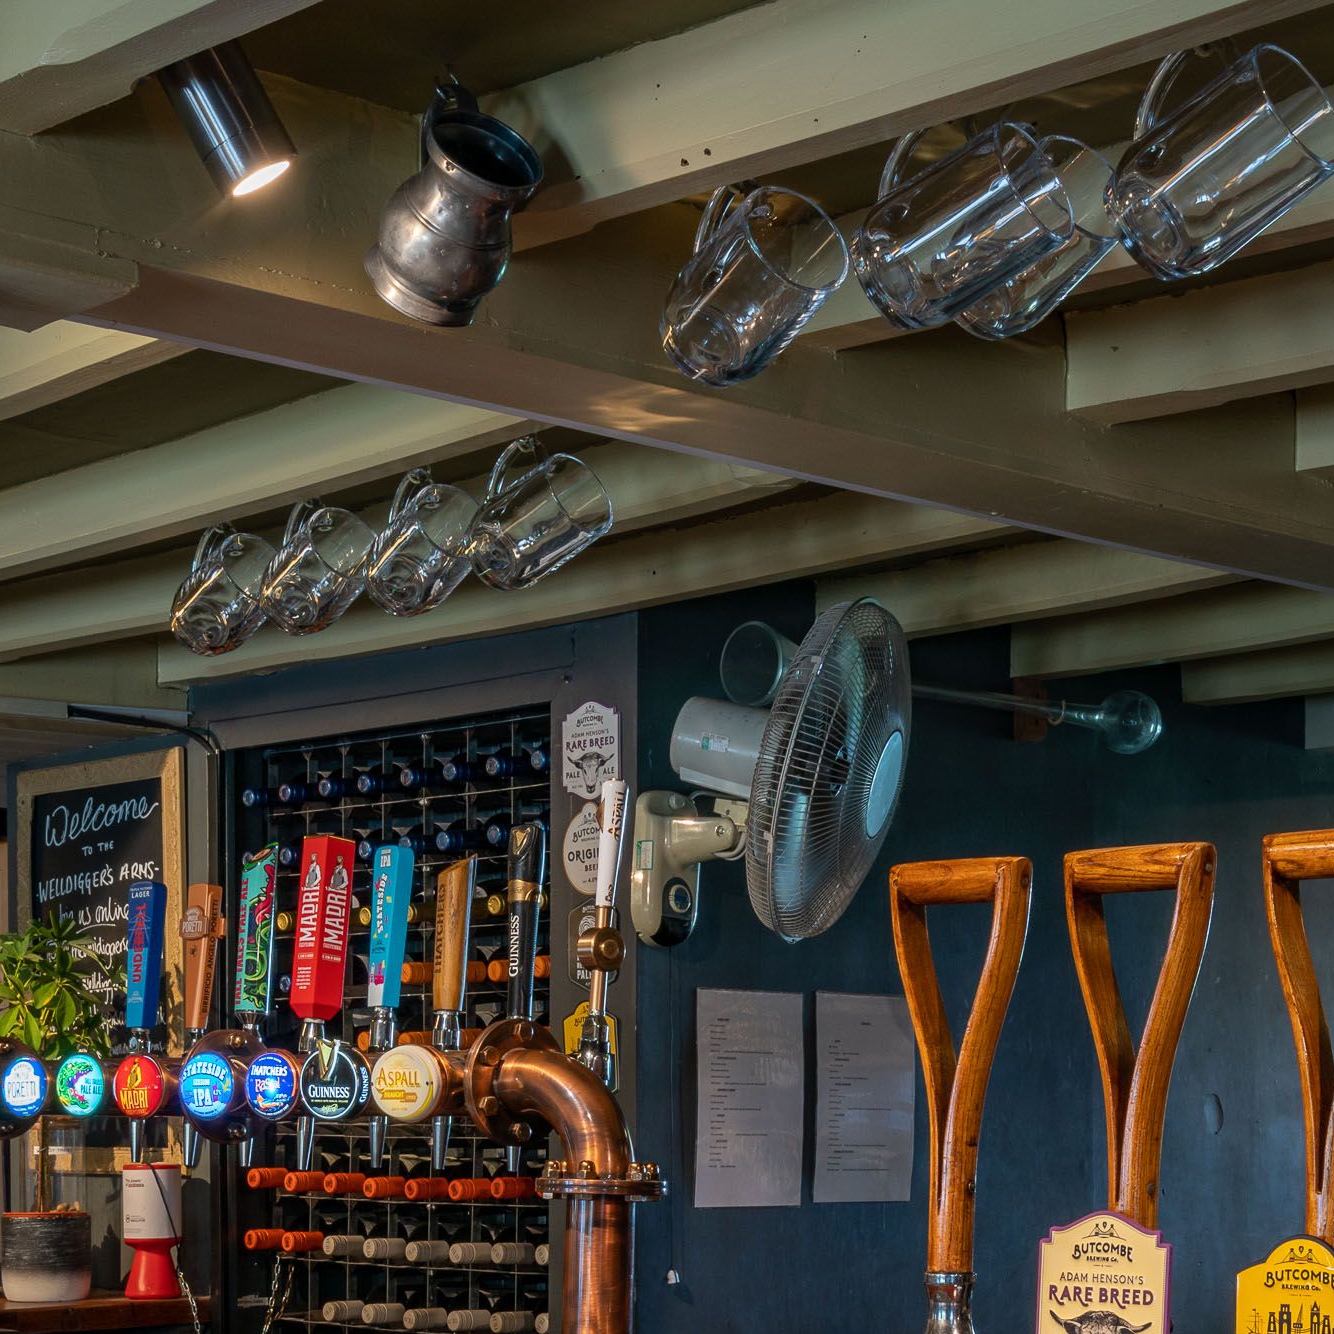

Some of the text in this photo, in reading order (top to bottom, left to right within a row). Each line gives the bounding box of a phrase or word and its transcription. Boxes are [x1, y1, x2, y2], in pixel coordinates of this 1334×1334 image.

[575, 715, 604, 728] BUTCOMBE
[571, 728, 610, 739] ADAM HENSON'S
[565, 736, 615, 753] RARE BREED
[565, 766, 616, 780] PALE ALE
[45, 796, 159, 847] Welcome
[82, 840, 115, 857] TO THE
[380, 854, 392, 868] IPA
[130, 890, 151, 899] LAGER
[241, 877, 249, 899] ALE
[377, 873, 388, 935] STATESIDE
[239, 903, 248, 933] PALE
[434, 884, 446, 974] THATCHERS
[508, 913, 520, 977] GUINNESS
[182, 1061, 228, 1081] STATESIDE
[250, 1064, 288, 1077] THATCHERS
[376, 1067, 420, 1087] ASPALL
[7, 1080, 38, 1099] PORETTI
[80, 1084, 92, 1095] PALE
[308, 1084, 350, 1099] GUINNESS
[359, 1066, 368, 1103] GUINNESS
[193, 1088, 212, 1108] IPA
[1071, 1241, 1134, 1263] BUTCOMBE
[1059, 1271, 1144, 1286] ADAM HENSON'S
[1281, 1283, 1310, 1292] BREWING
[1048, 1284, 1154, 1310] RARE BREED
